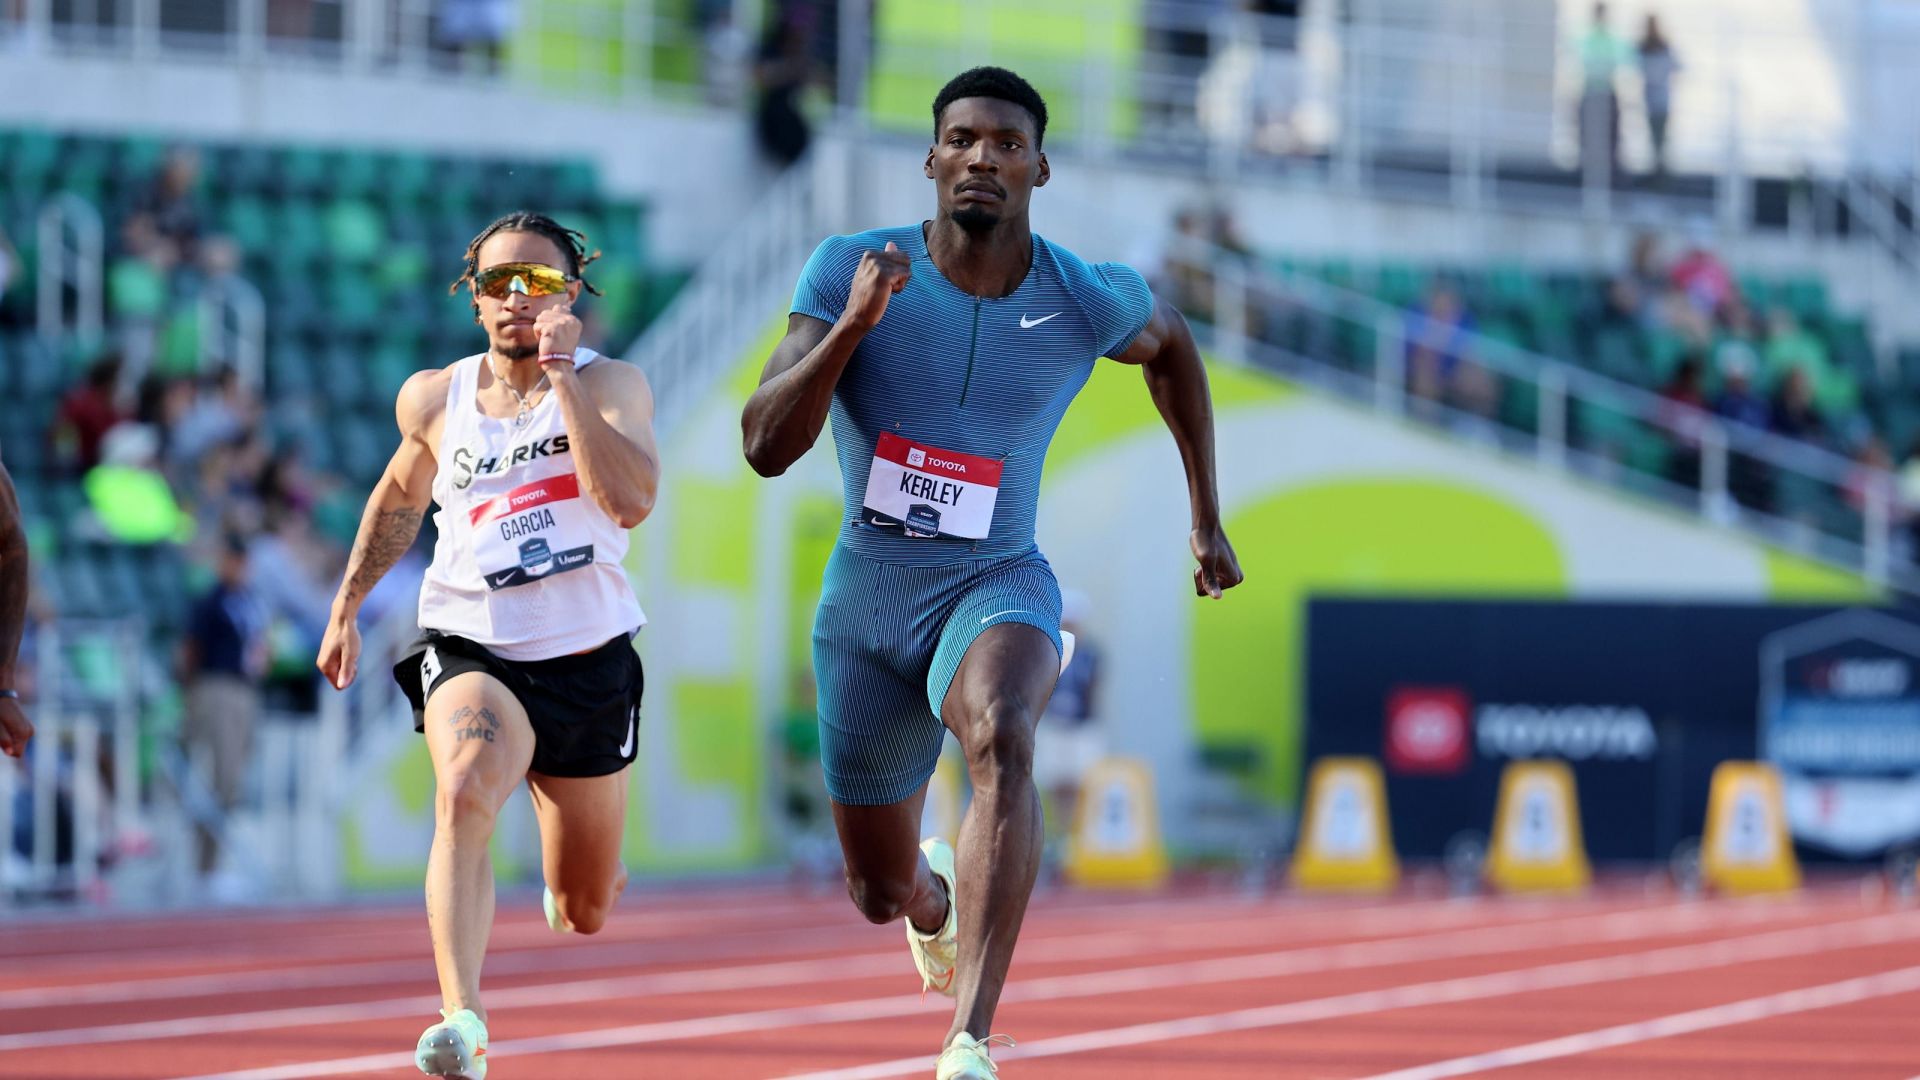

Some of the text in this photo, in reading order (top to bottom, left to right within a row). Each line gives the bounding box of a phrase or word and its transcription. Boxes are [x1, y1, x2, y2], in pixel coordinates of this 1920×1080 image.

[453, 435, 570, 489] SHARKS
[928, 457, 966, 473] TOYOTA
[511, 489, 547, 506] TOYOTA
[899, 471, 964, 506] KERLEY
[500, 508, 555, 541] GARCIA
[455, 727, 495, 743] TMC
